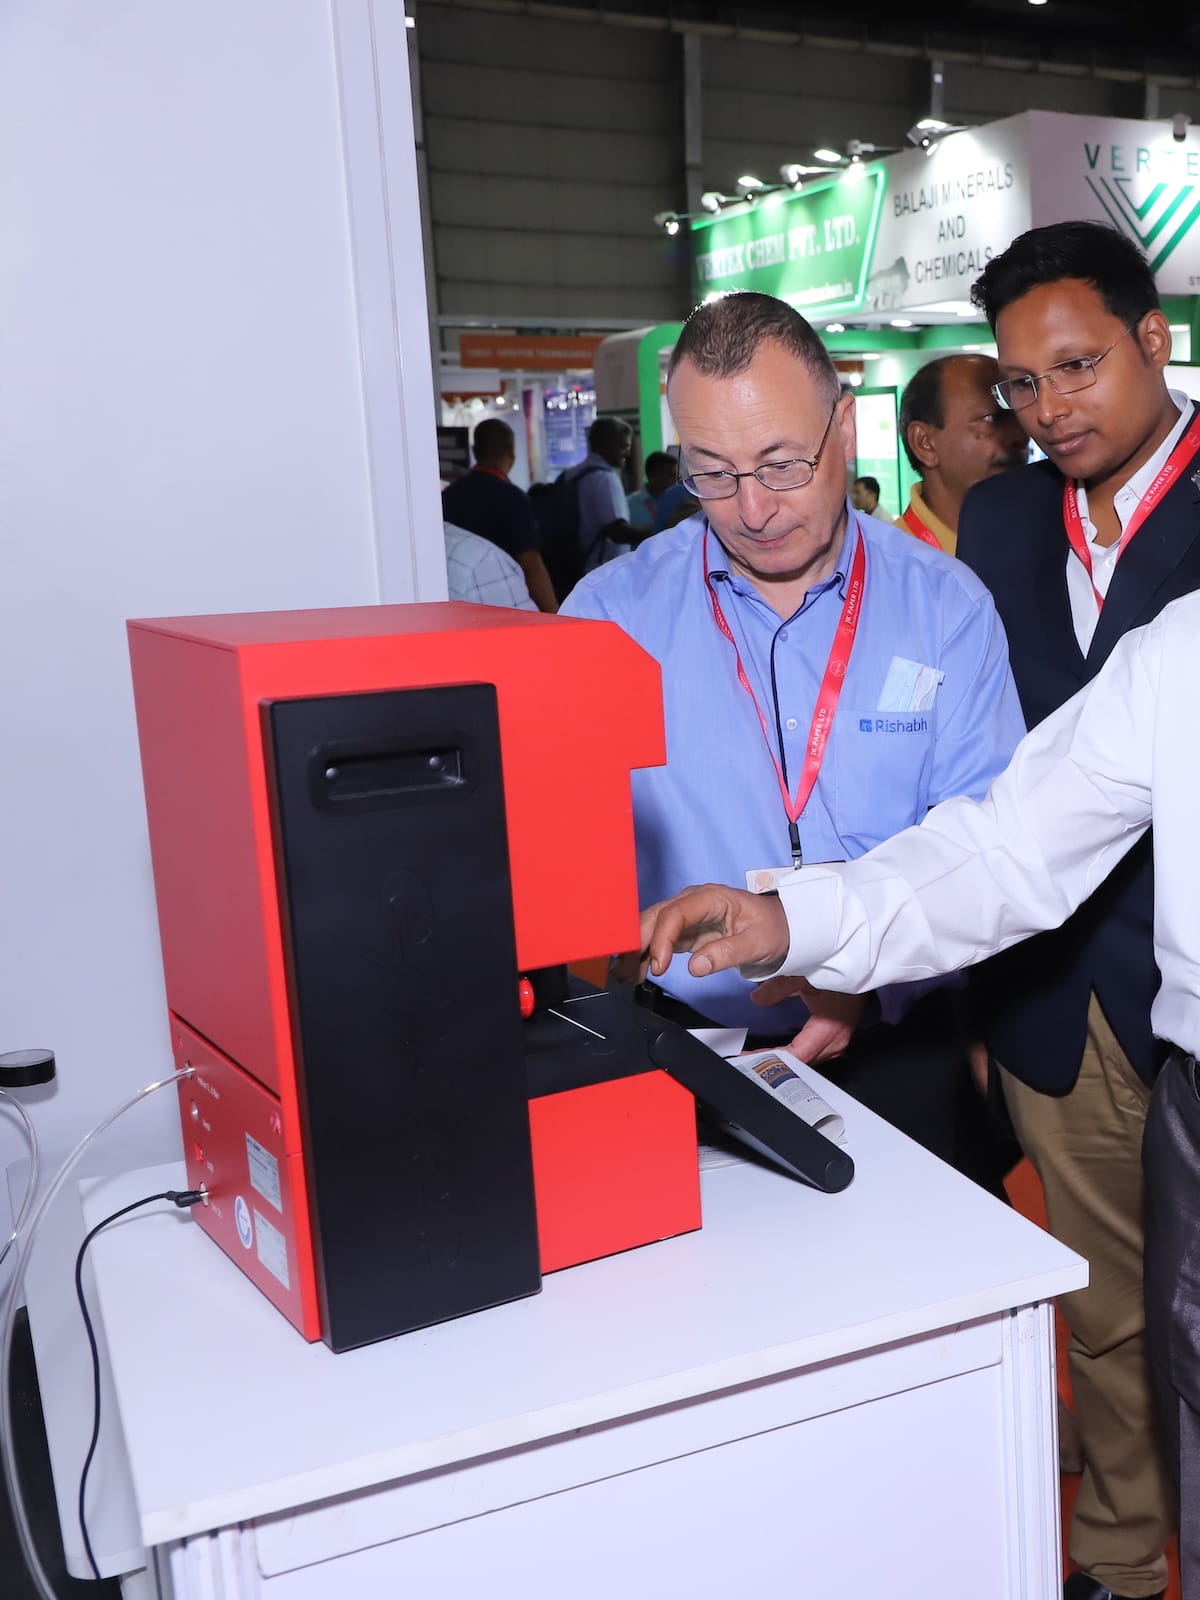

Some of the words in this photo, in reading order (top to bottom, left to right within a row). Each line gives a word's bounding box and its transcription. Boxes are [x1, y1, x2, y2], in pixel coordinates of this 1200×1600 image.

[894, 184, 938, 217] BALAJI
[942, 163, 1013, 204] MINERALS
[788, 224, 821, 260] PVT.
[824, 214, 860, 252] LTD.
[938, 215, 966, 243] AND
[875, 718, 928, 733] Rishabh
